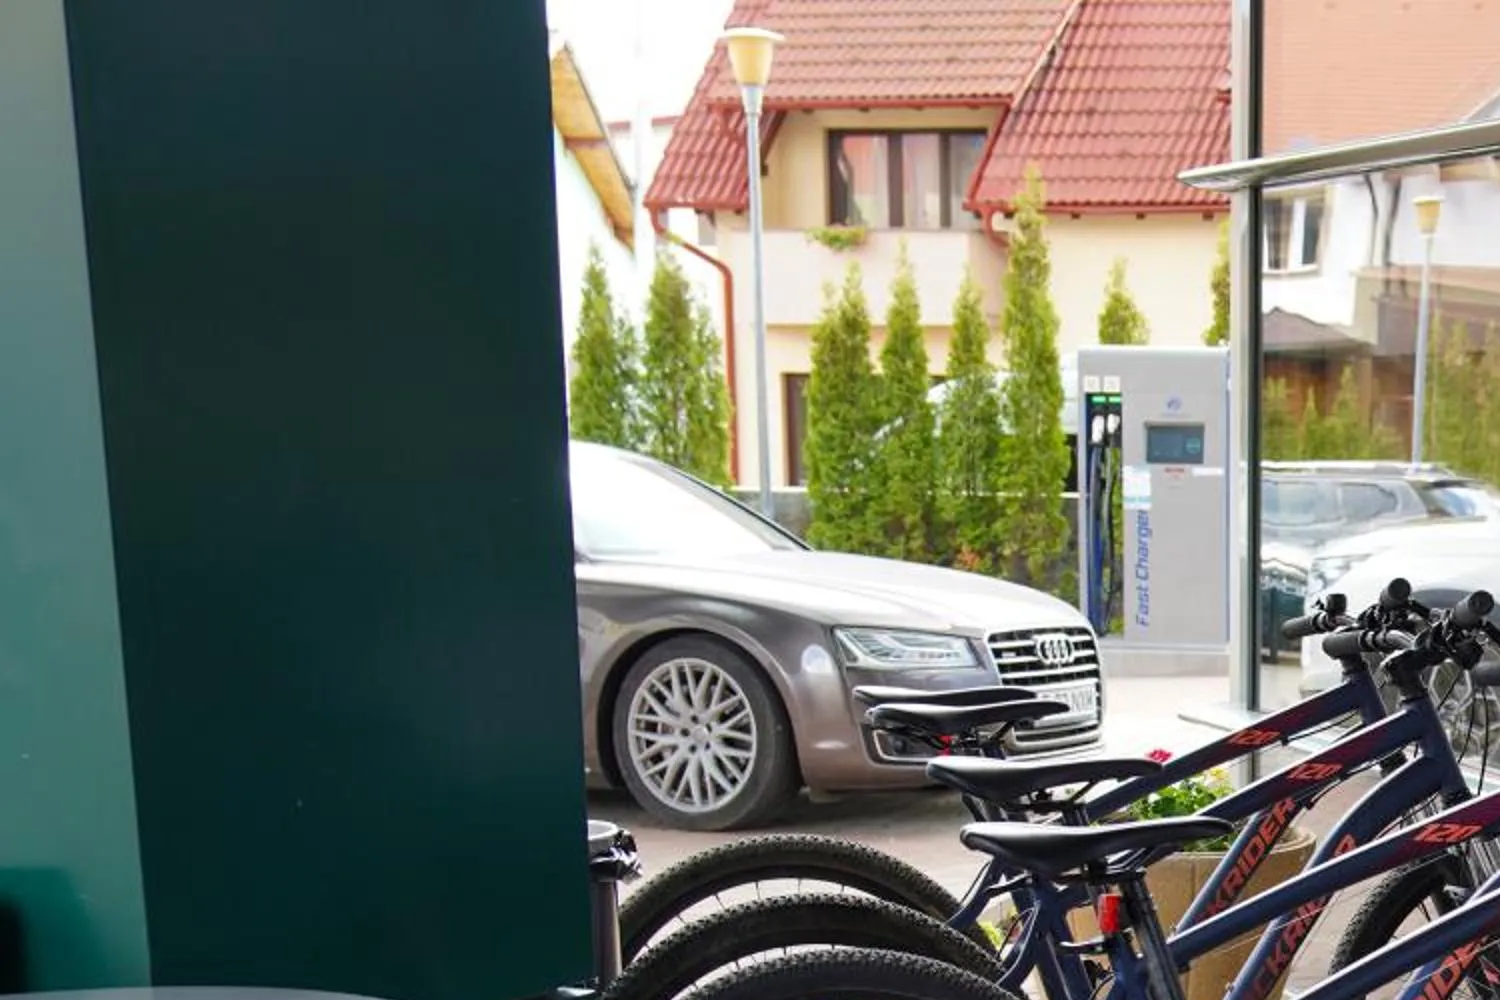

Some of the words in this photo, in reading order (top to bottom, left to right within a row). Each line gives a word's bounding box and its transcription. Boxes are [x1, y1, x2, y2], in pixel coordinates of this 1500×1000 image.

[1135, 585, 1149, 627] Fast
[1286, 762, 1343, 780] 120
[1413, 823, 1483, 842] 120
